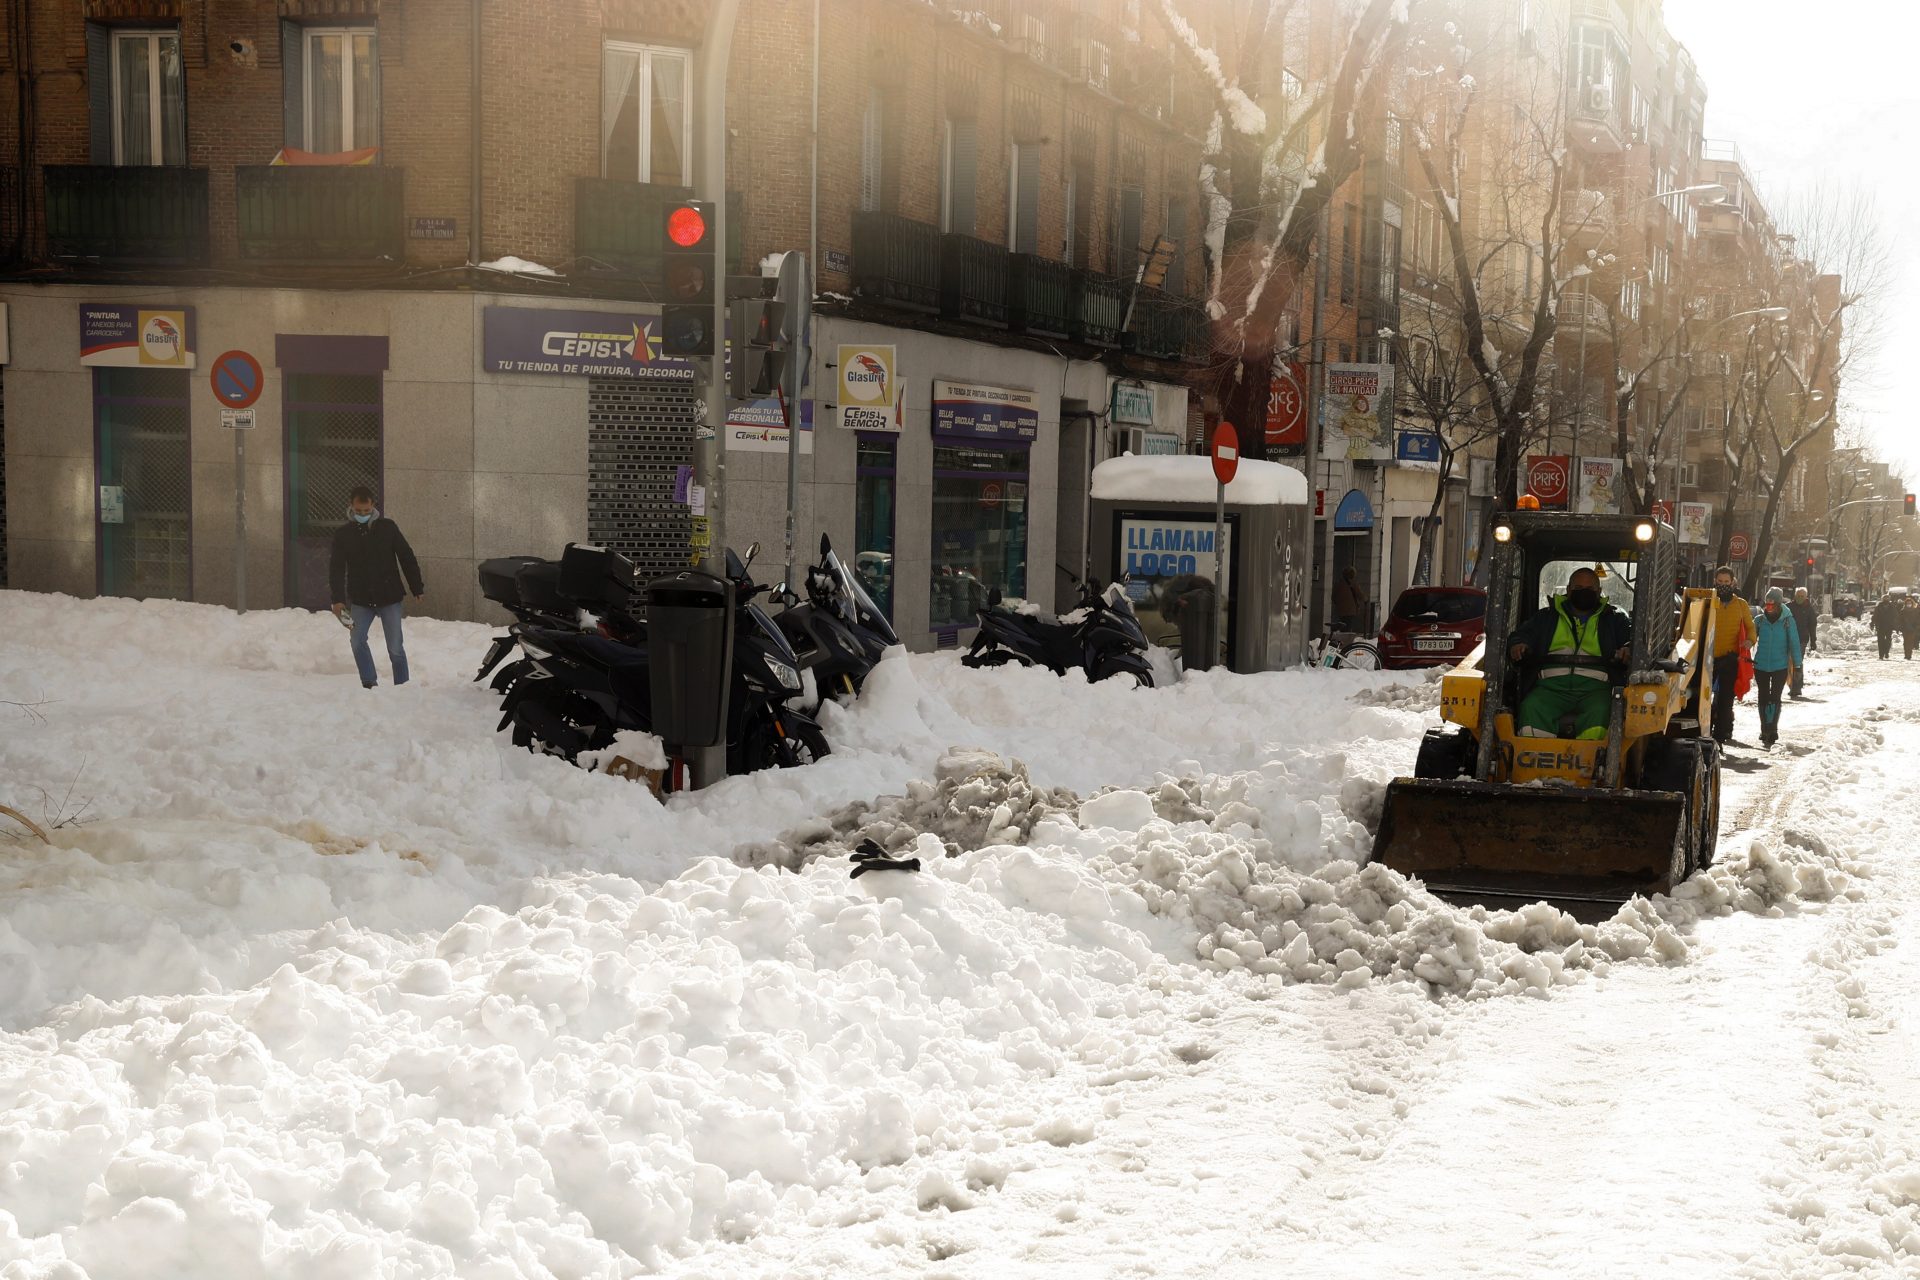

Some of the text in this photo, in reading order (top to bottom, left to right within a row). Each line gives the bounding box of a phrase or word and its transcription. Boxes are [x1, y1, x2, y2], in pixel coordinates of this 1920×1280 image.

[542, 332, 621, 359] CEPISA
[498, 360, 695, 379] TU TIENDA DE PINTURA, DECORACI
[848, 371, 885, 383] Glasurit
[1330, 377, 1377, 386] CIRCO PRICE
[1330, 386, 1376, 395] EN NAVIDAD
[1267, 391, 1294, 414] RICE
[728, 414, 784, 423] PERSONALIZ
[844, 407, 880, 419] CEPISA
[939, 410, 954, 418] BELLAS
[844, 416, 887, 428] BEMCOR
[939, 420, 953, 429] ARTES
[736, 431, 759, 439] CEPISA
[1422, 438, 1430, 448] 2
[1534, 472, 1560, 486] PRICE
[1128, 527, 1217, 552] LLÁMAM
[1128, 552, 1196, 576] LOCO
[1283, 544, 1291, 627] VIDRIO
[1517, 751, 1589, 771] GEHL
